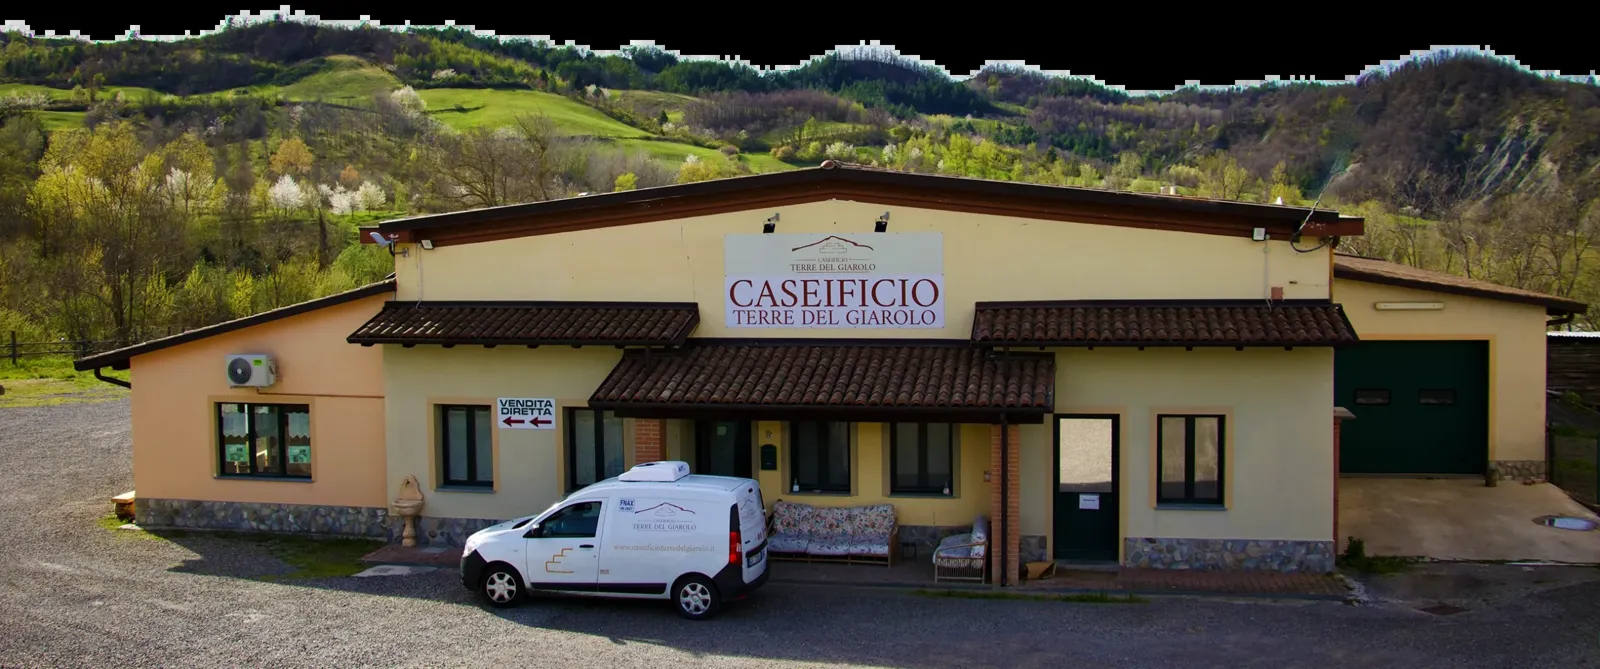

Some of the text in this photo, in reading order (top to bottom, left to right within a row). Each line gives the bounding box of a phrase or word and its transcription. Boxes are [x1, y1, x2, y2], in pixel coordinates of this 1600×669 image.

[729, 279, 939, 308] CASEIFICIO
[732, 310, 936, 325] TERRE DEL GIAROLO
[500, 399, 552, 408] VENDITA
[501, 408, 552, 416] DIRETTA
[614, 544, 715, 552] www.caseificioterredelgiarolo.it
